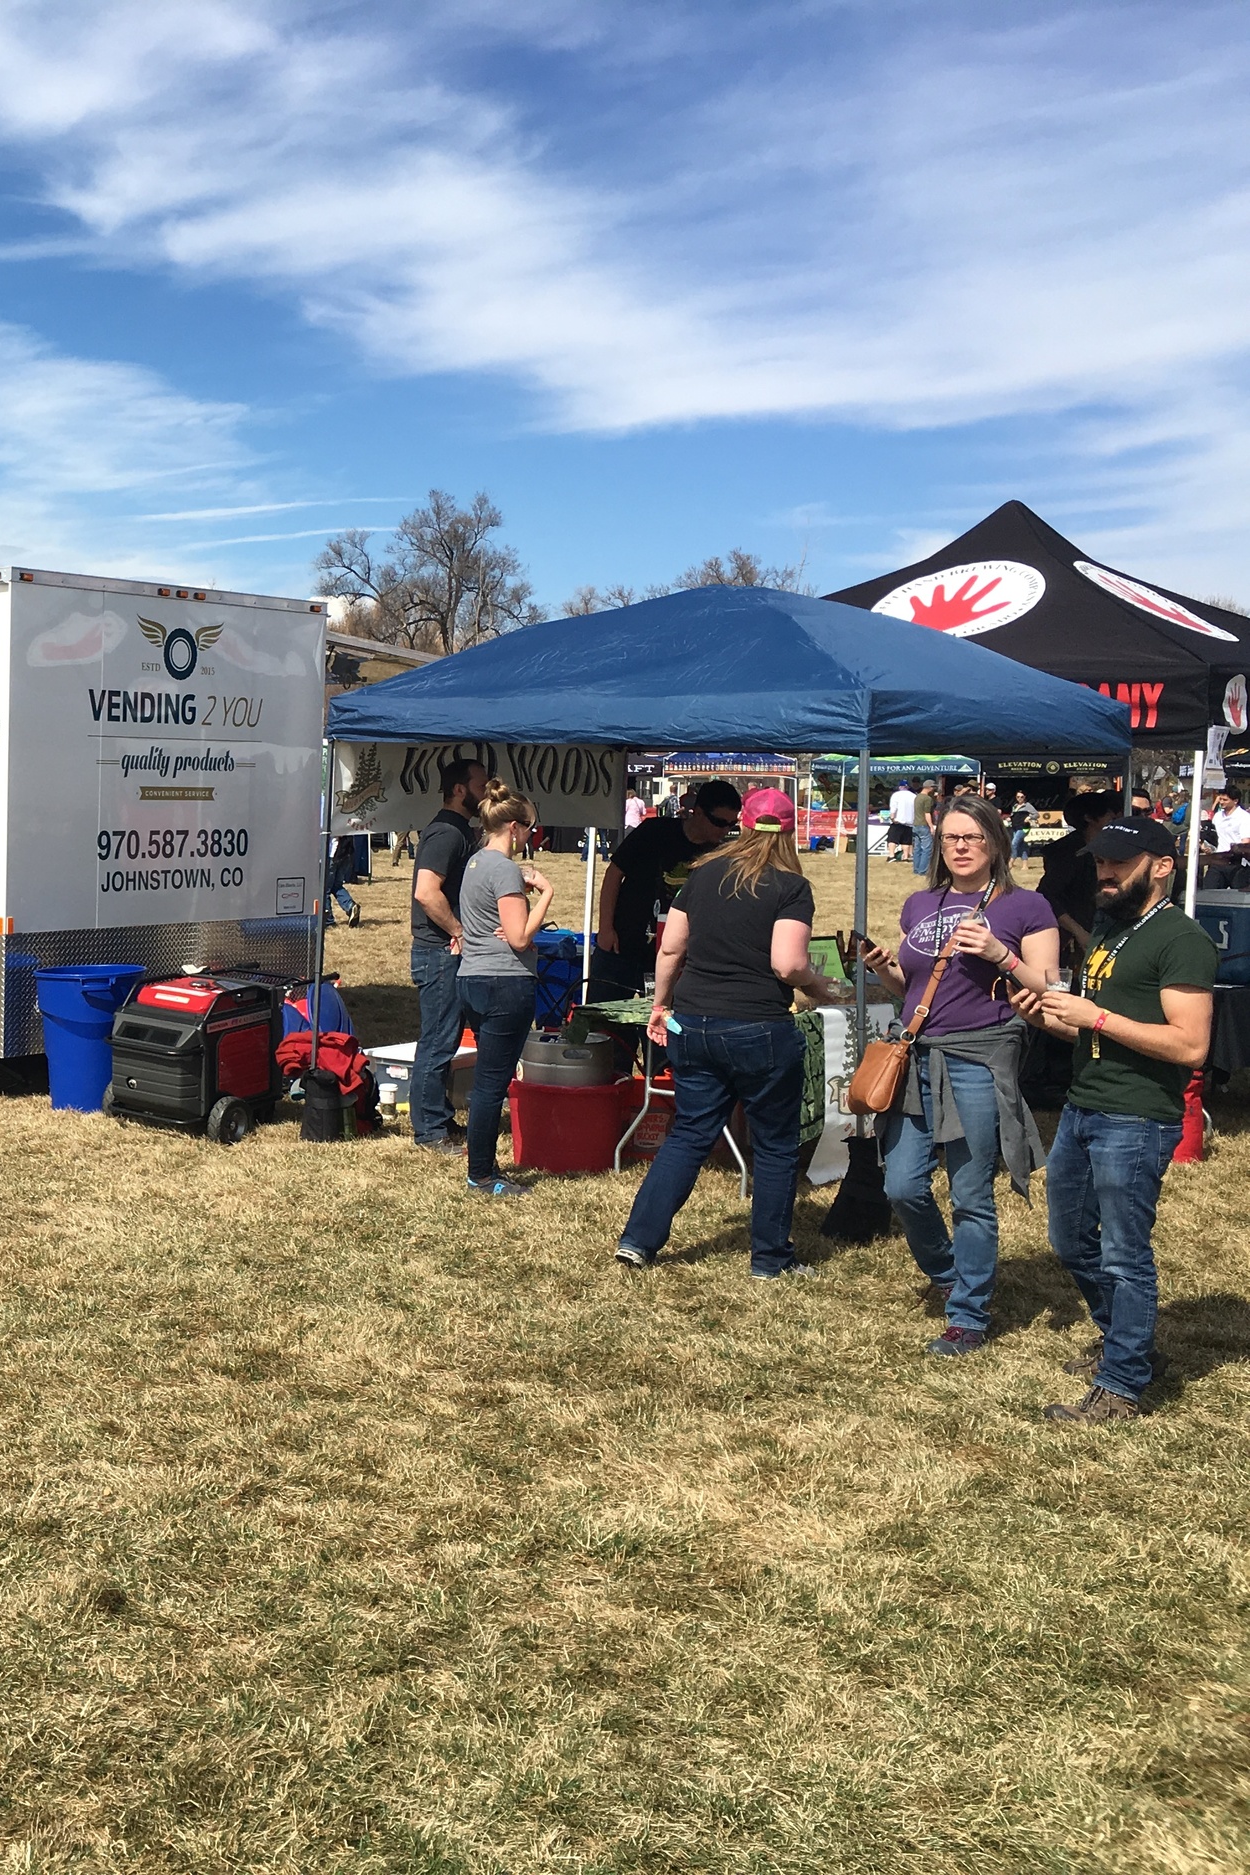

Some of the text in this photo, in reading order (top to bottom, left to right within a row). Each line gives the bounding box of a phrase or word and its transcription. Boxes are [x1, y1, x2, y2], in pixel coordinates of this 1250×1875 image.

[141, 662, 161, 672] ESTD
[200, 666, 215, 676] 2015
[88, 688, 263, 728] VENDING 2 YOU
[122, 746, 235, 778] quality products
[507, 743, 613, 797] WOODS
[998, 761, 1042, 769] ELEVATION
[1063, 761, 1108, 769] ELEVATION
[97, 828, 249, 860] 970.587.3830
[101, 867, 243, 893] JOHNSTOWN, CO
[1133, 907, 1159, 931] COLORADO
[1116, 936, 1129, 950] TRAIL
